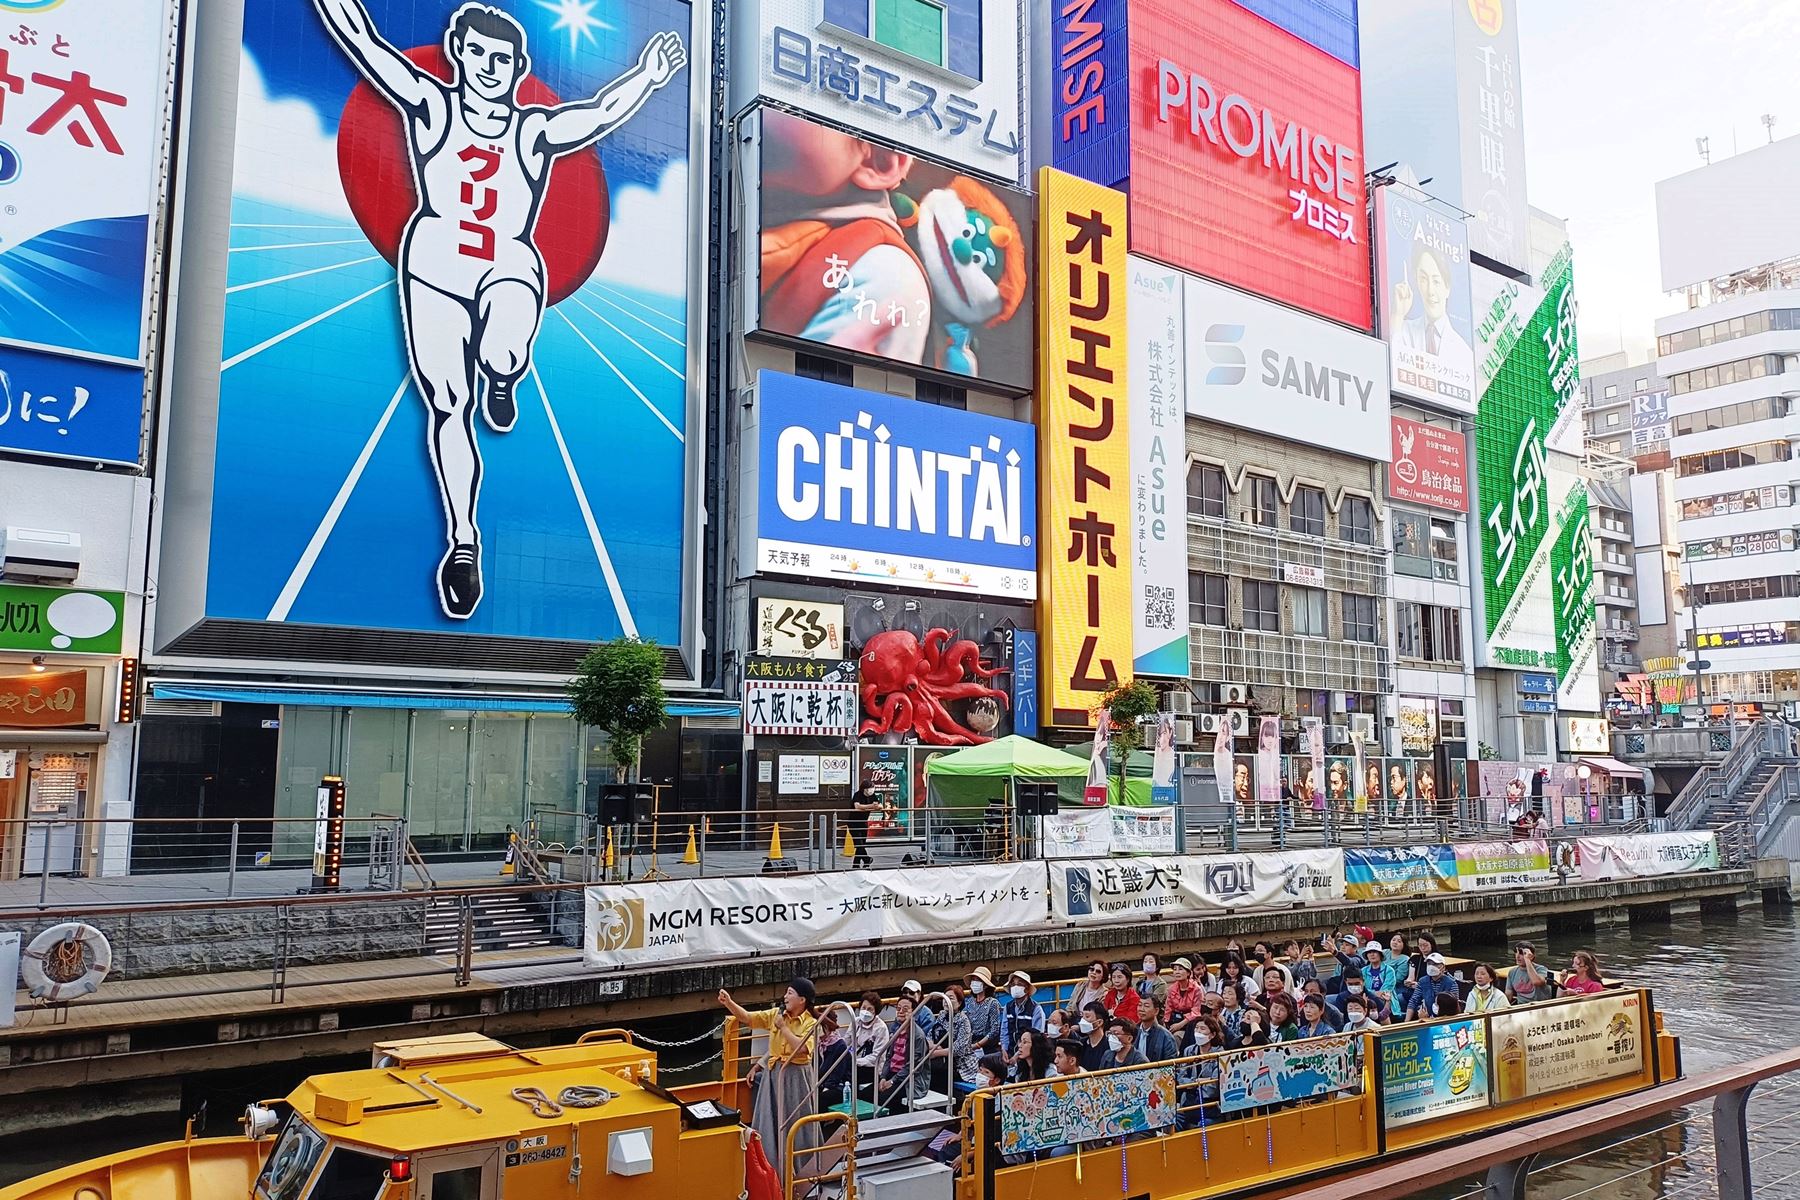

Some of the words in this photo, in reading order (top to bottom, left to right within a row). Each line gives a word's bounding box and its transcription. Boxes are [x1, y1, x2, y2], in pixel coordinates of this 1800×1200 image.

[774, 26, 1020, 156] 日商エステム
[1158, 58, 1356, 206] PROMISE
[457, 144, 504, 261] グリコ
[1288, 189, 1357, 244] プロミス
[1414, 221, 1463, 263] Asking!
[1134, 271, 1164, 293] Asue
[1148, 340, 1164, 427] 株式会社
[1261, 349, 1374, 413] SAMTY
[1066, 209, 1117, 691] オリエントホーム
[777, 410, 1021, 546] CHINTAI
[1149, 435, 1166, 542] Asue
[1488, 417, 1548, 588] エイブル
[768, 548, 811, 568] 天気予報
[1557, 515, 1595, 619] エイブル
[774, 607, 827, 650] くくる
[1005, 629, 1014, 660] 2F
[747, 660, 827, 678] 大阪もんを食す
[1018, 639, 1033, 728] ペンギンバー
[751, 689, 842, 728] 大阪に乾杯
[1096, 864, 1182, 897] 近畿大学
[650, 908, 702, 932] MGM
[711, 902, 813, 926] RESORTS
[1098, 901, 1131, 912] KINDAI
[1134, 895, 1186, 908] UNIVERSITY
[648, 933, 684, 947] JAPAN
[1623, 998, 1638, 1008] KIRIN
[1527, 1026, 1549, 1038] ようこそ!
[1550, 1021, 1562, 1032] 大阪
[1527, 1041, 1555, 1053] Welcome!
[1557, 1037, 1575, 1047] Osaka
[1576, 1031, 1603, 1043] Dotonbori
[1607, 1037, 1635, 1055] 一番搾り
[1383, 1041, 1419, 1062] とんぼり
[1404, 1081, 1417, 1092] River
[1418, 1078, 1434, 1089] Cruise
[523, 1136, 545, 1148] 大阪
